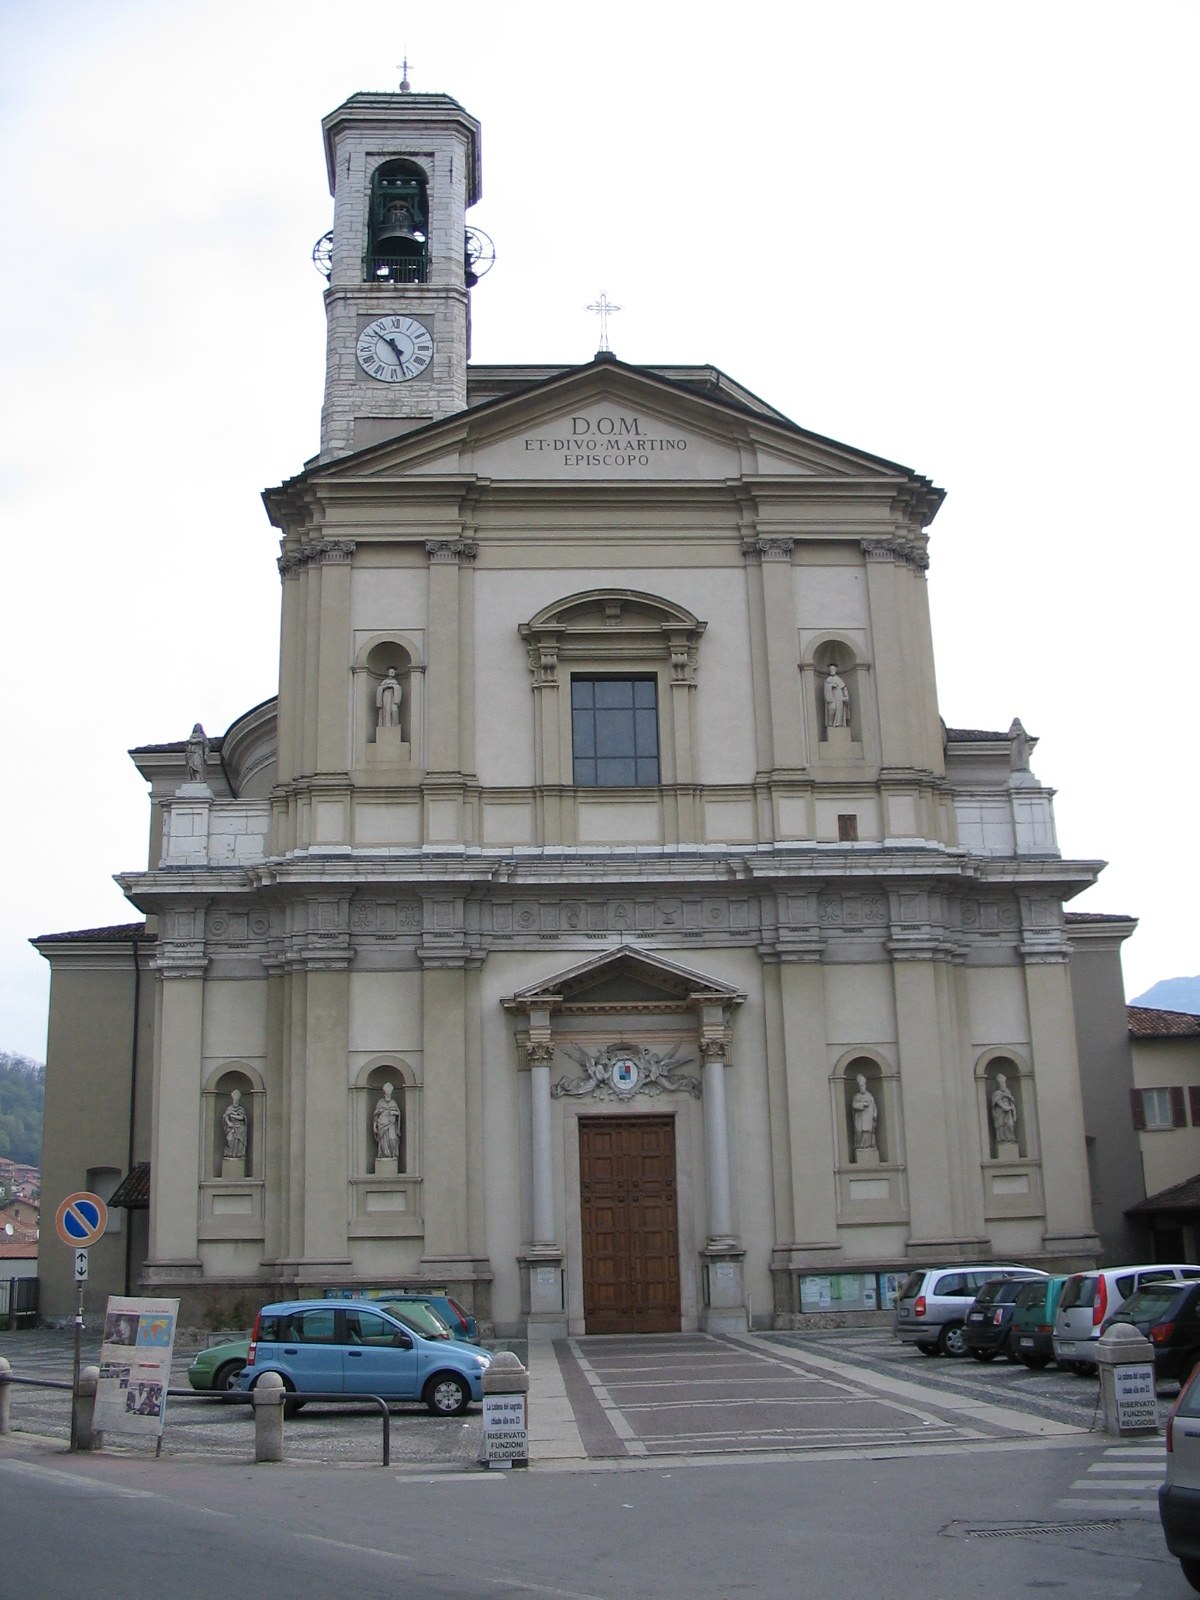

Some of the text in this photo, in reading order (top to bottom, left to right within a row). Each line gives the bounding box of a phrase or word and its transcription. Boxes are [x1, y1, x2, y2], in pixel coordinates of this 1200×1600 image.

[571, 417, 647, 436] D.O.M.
[564, 454, 649, 466] EPISCOPO
[1119, 1400, 1156, 1408] RISERVATO
[1123, 1409, 1154, 1417] FUNZIONI
[1121, 1418, 1156, 1427] RELIGIOSE
[487, 1431, 526, 1440] RISERVATO
[490, 1441, 524, 1449] FUNZIONI
[488, 1450, 527, 1459] RELIGIOSE
